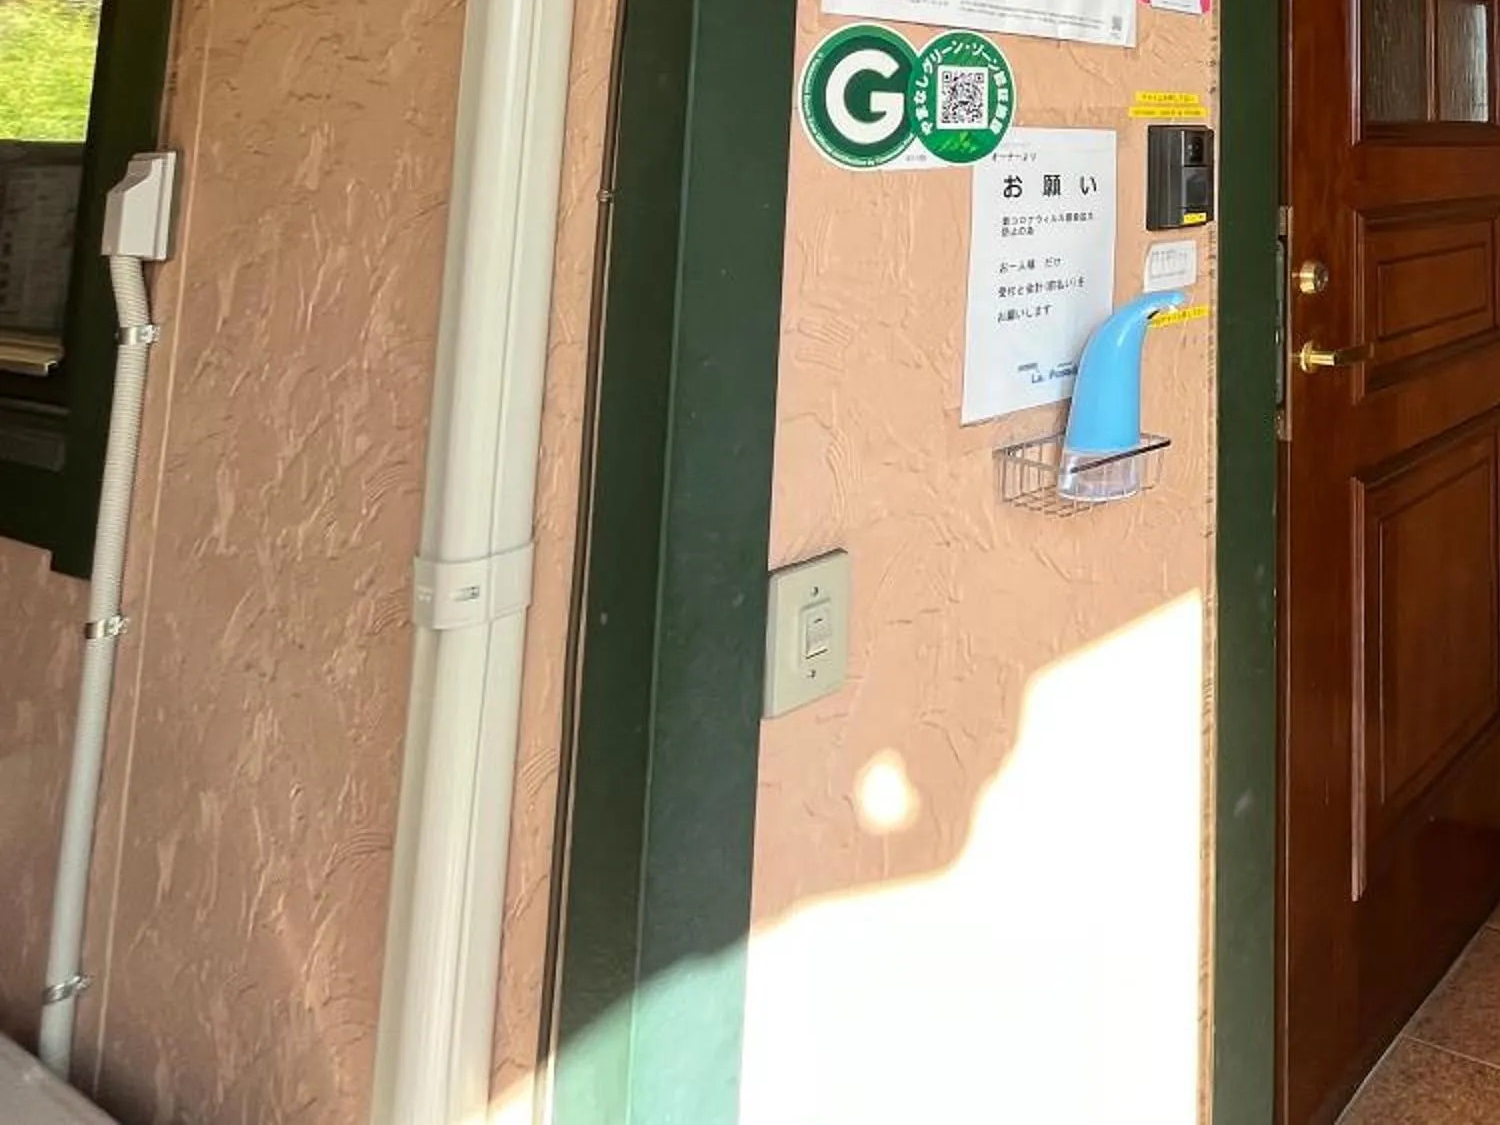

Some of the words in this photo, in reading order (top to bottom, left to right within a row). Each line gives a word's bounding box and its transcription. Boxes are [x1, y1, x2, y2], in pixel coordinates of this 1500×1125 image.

[998, 304, 1053, 323] お願いします
